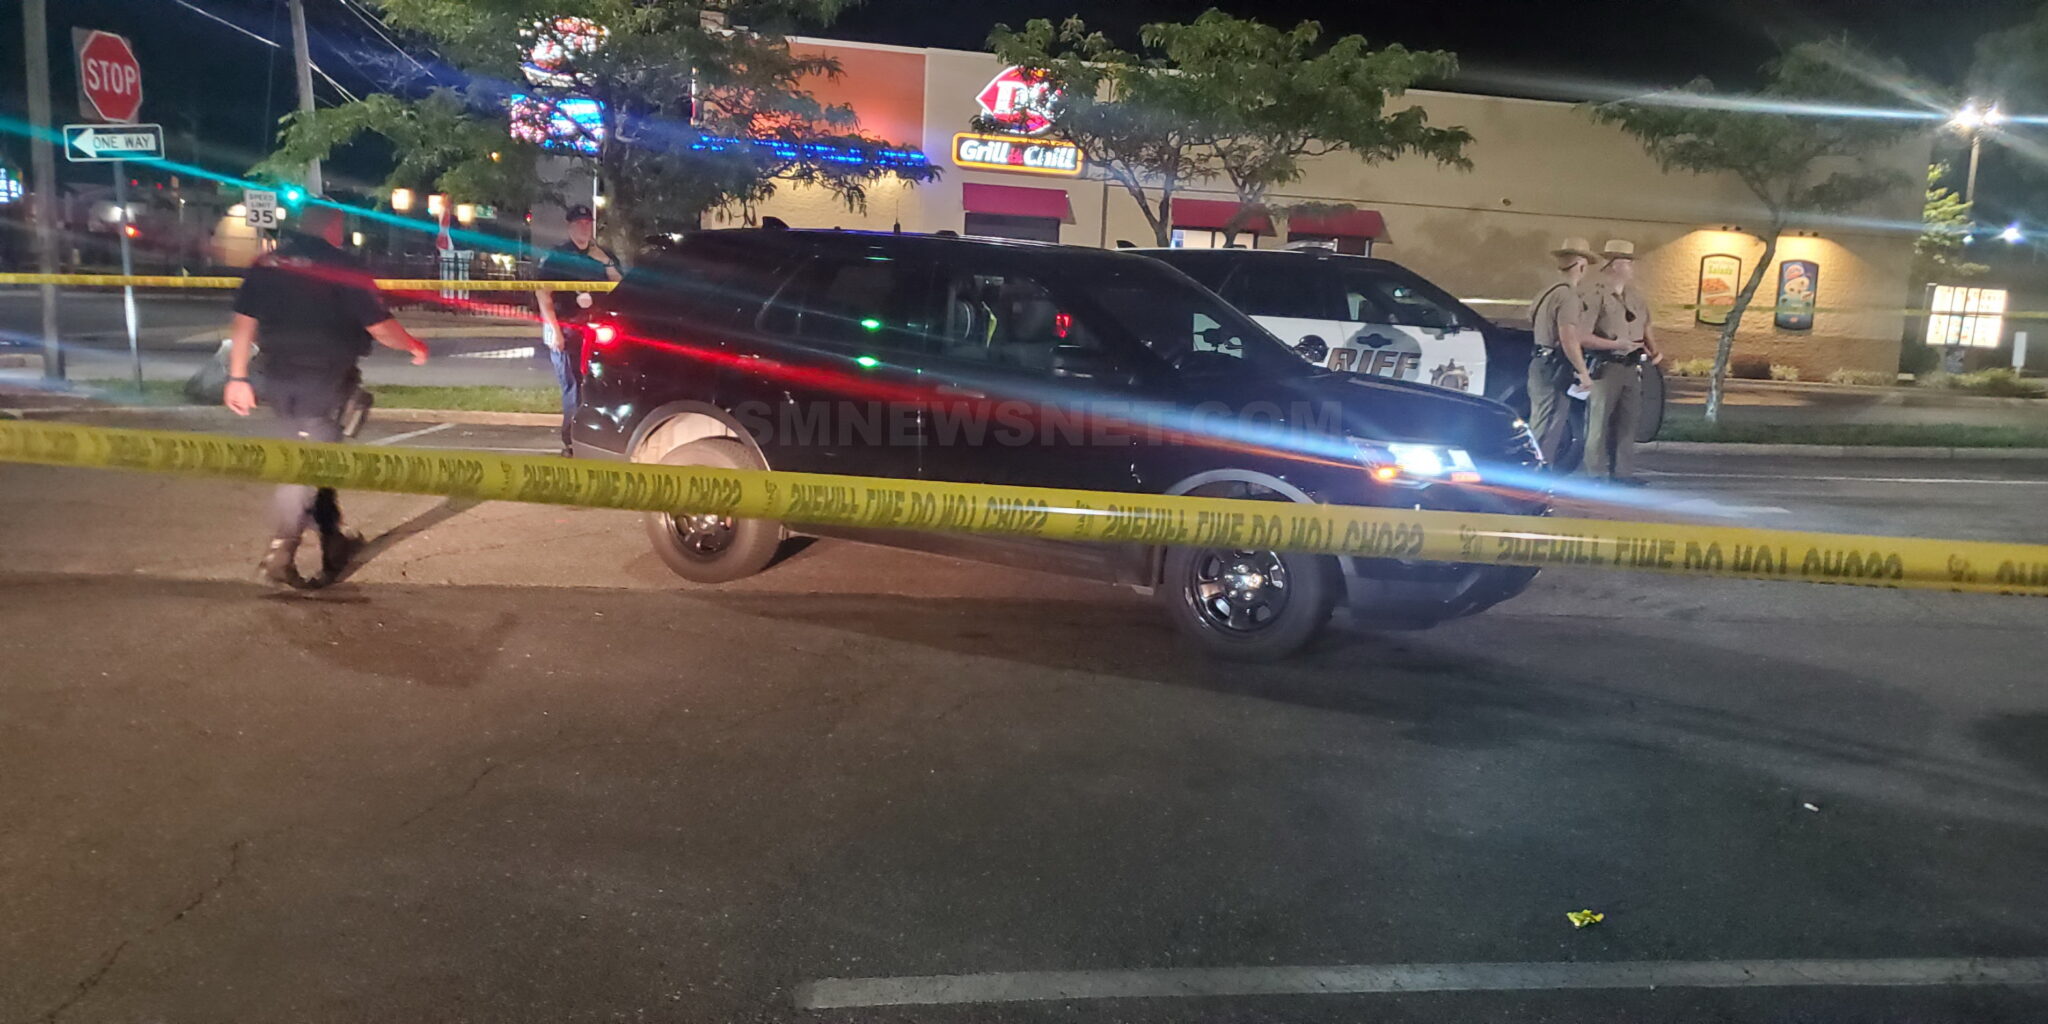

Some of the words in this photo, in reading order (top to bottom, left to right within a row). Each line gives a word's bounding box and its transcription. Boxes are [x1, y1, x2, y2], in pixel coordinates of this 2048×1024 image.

[87, 58, 136, 95] STOP
[93, 136, 119, 149] ONE
[124, 136, 150, 149] WAY
[960, 140, 1010, 164] Grill
[1023, 145, 1076, 169] Chill
[249, 209, 273, 224] 35
